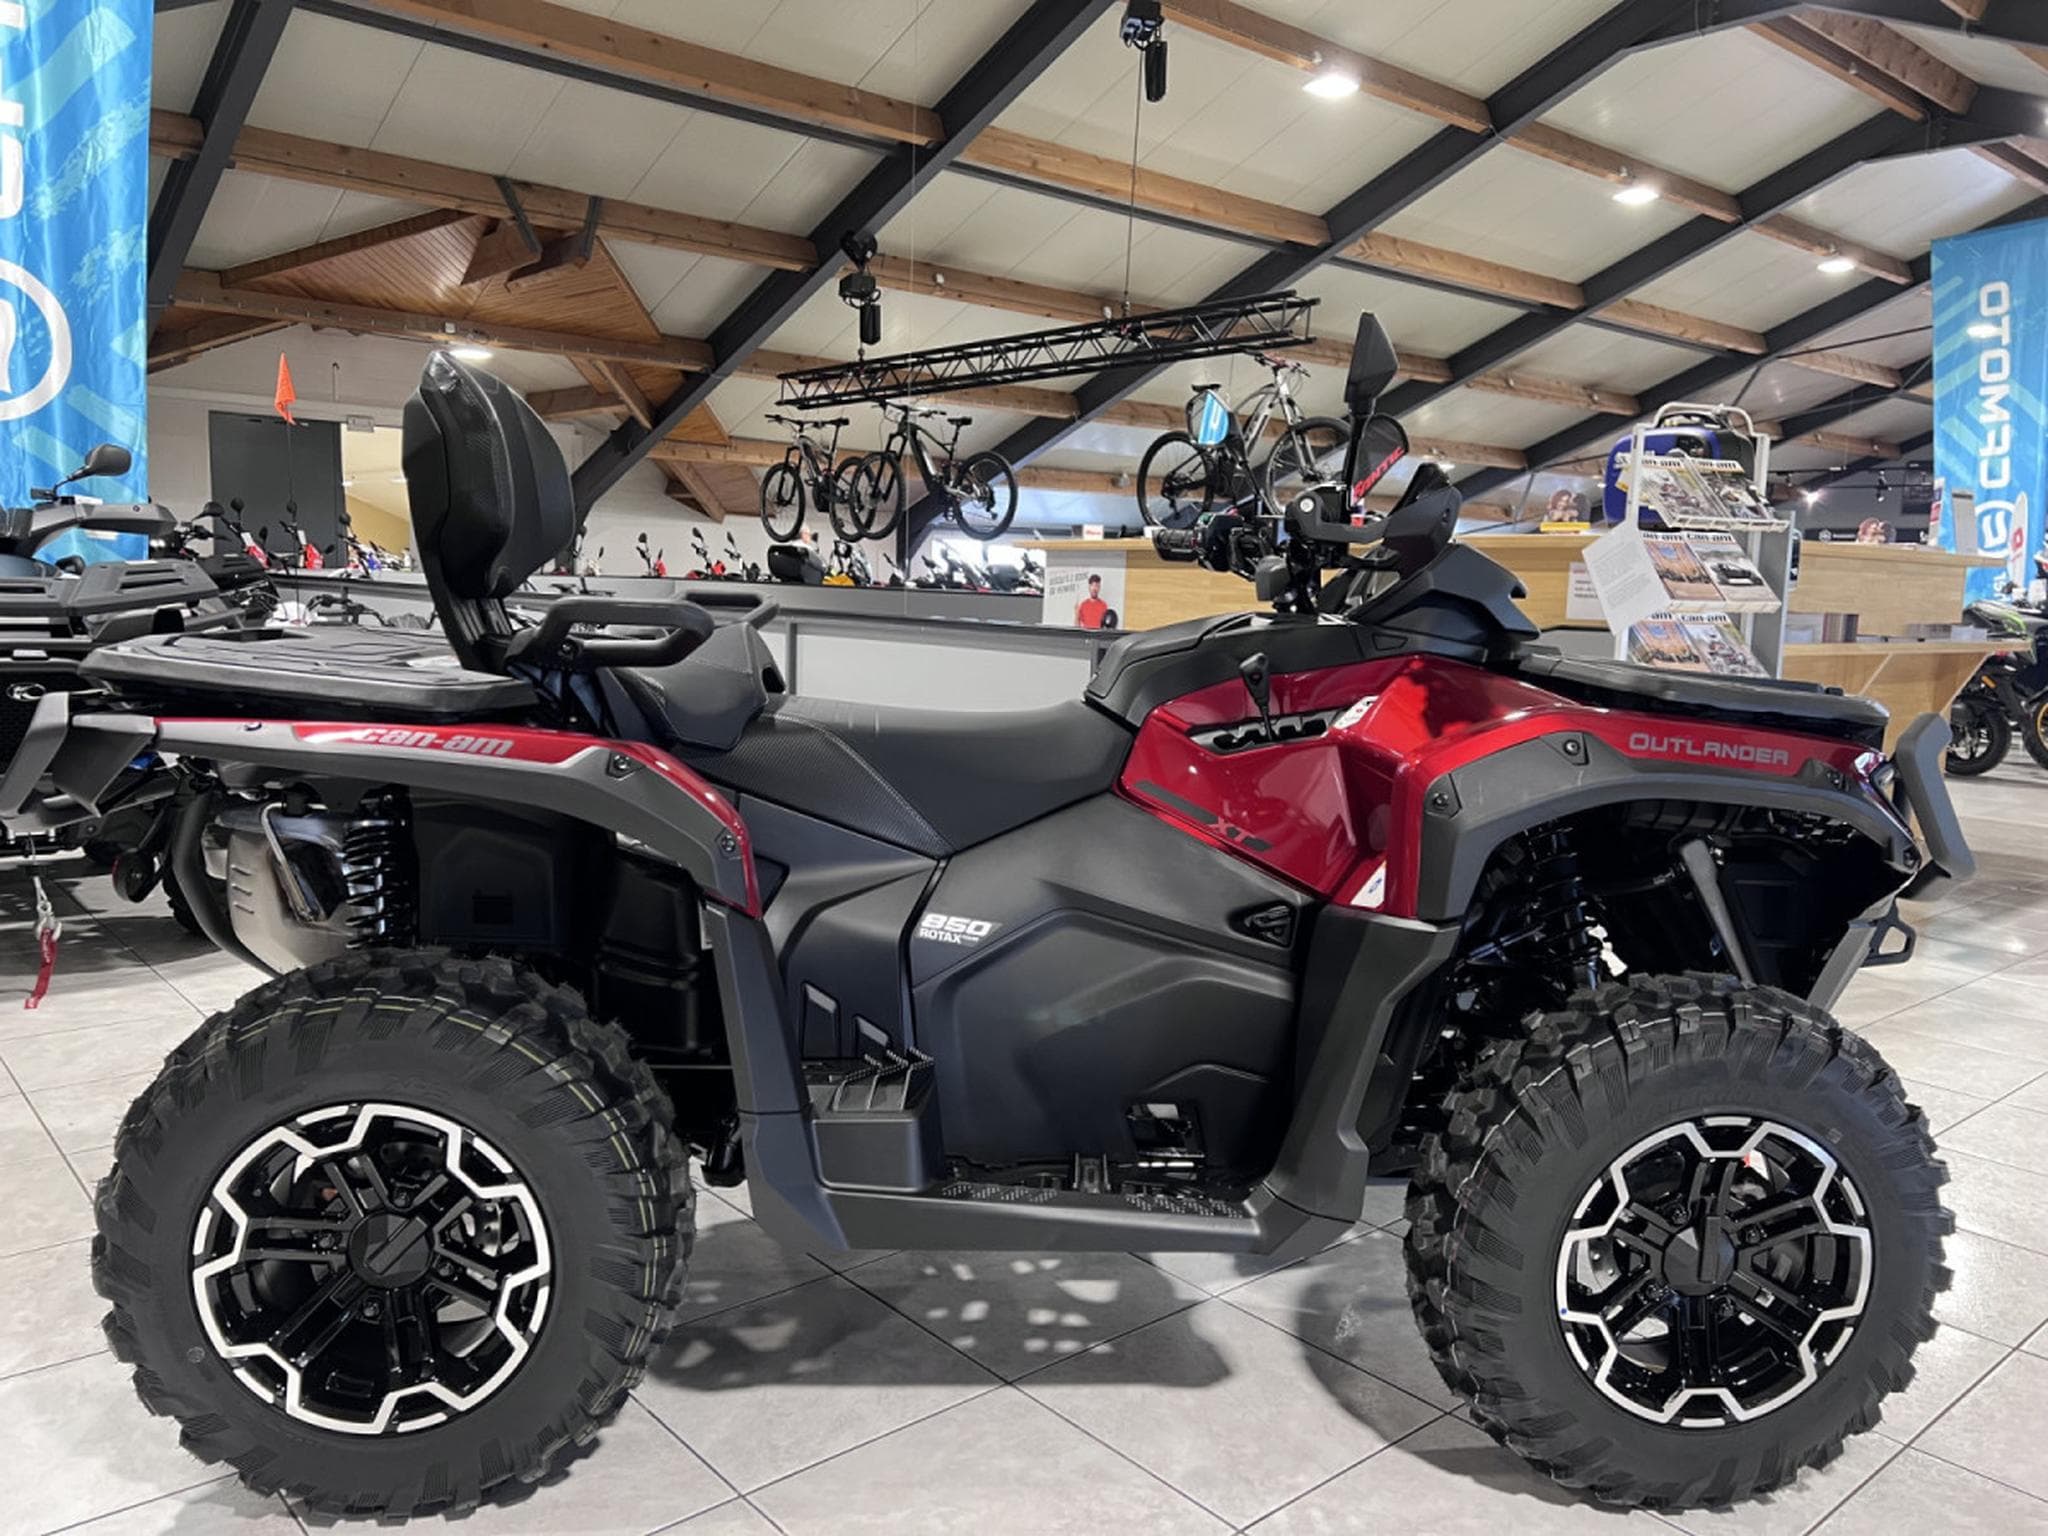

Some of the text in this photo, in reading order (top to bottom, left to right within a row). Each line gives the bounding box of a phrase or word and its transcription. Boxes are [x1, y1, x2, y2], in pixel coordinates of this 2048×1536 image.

[353, 728, 514, 755] can-am
[1629, 732, 1789, 765] OUTLANDER
[919, 928, 962, 944] ROTAX
[921, 913, 992, 938] 850
